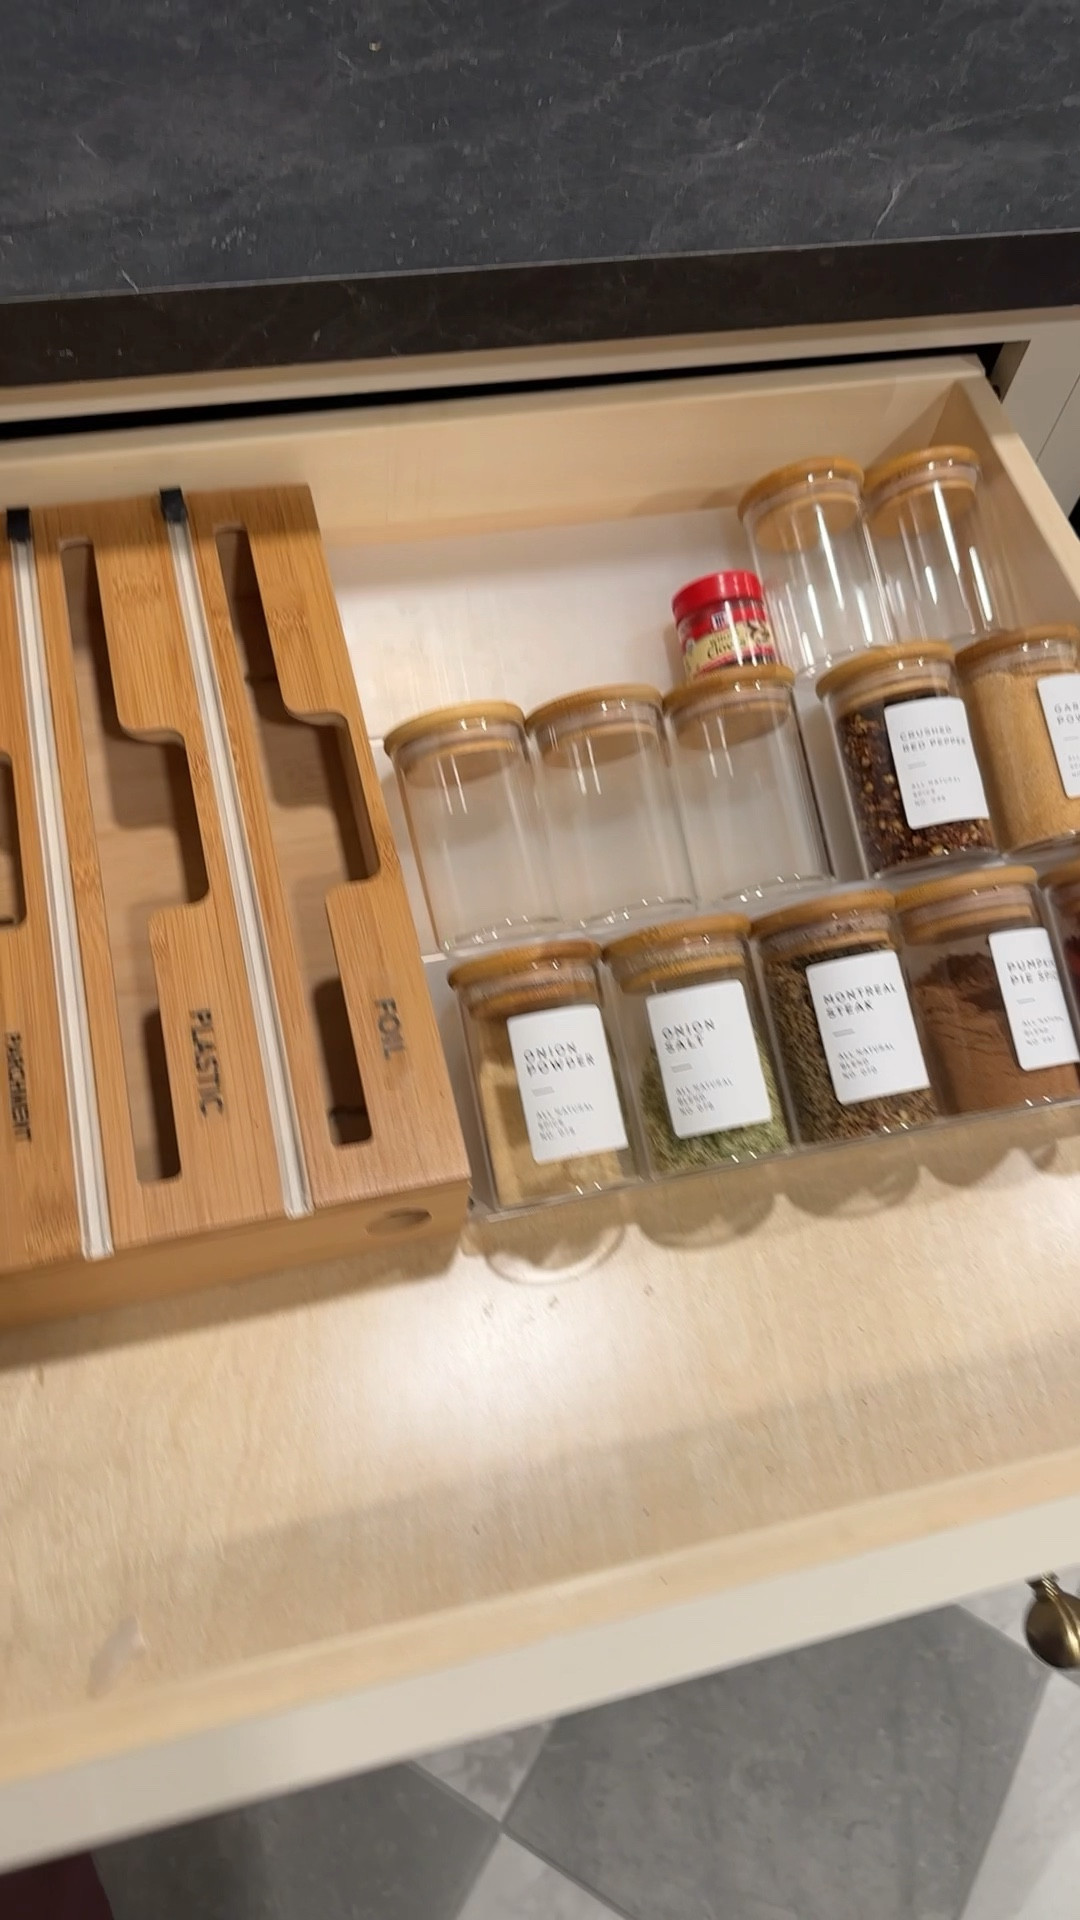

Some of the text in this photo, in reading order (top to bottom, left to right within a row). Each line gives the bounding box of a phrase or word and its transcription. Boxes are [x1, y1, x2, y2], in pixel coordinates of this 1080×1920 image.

[900, 724, 952, 741] CRUSHED
[902, 741, 926, 754] RED
[1010, 972, 1034, 986] PIE
[822, 982, 898, 1006] MONTREAL
[826, 1000, 874, 1020] STEAK
[374, 997, 405, 1061] FOIL
[661, 1018, 716, 1041] ONION
[523, 1040, 577, 1062] ONION
[664, 1034, 705, 1055] SALT
[190, 1008, 224, 1118] PLASTIC
[526, 1052, 595, 1077] POWDER
